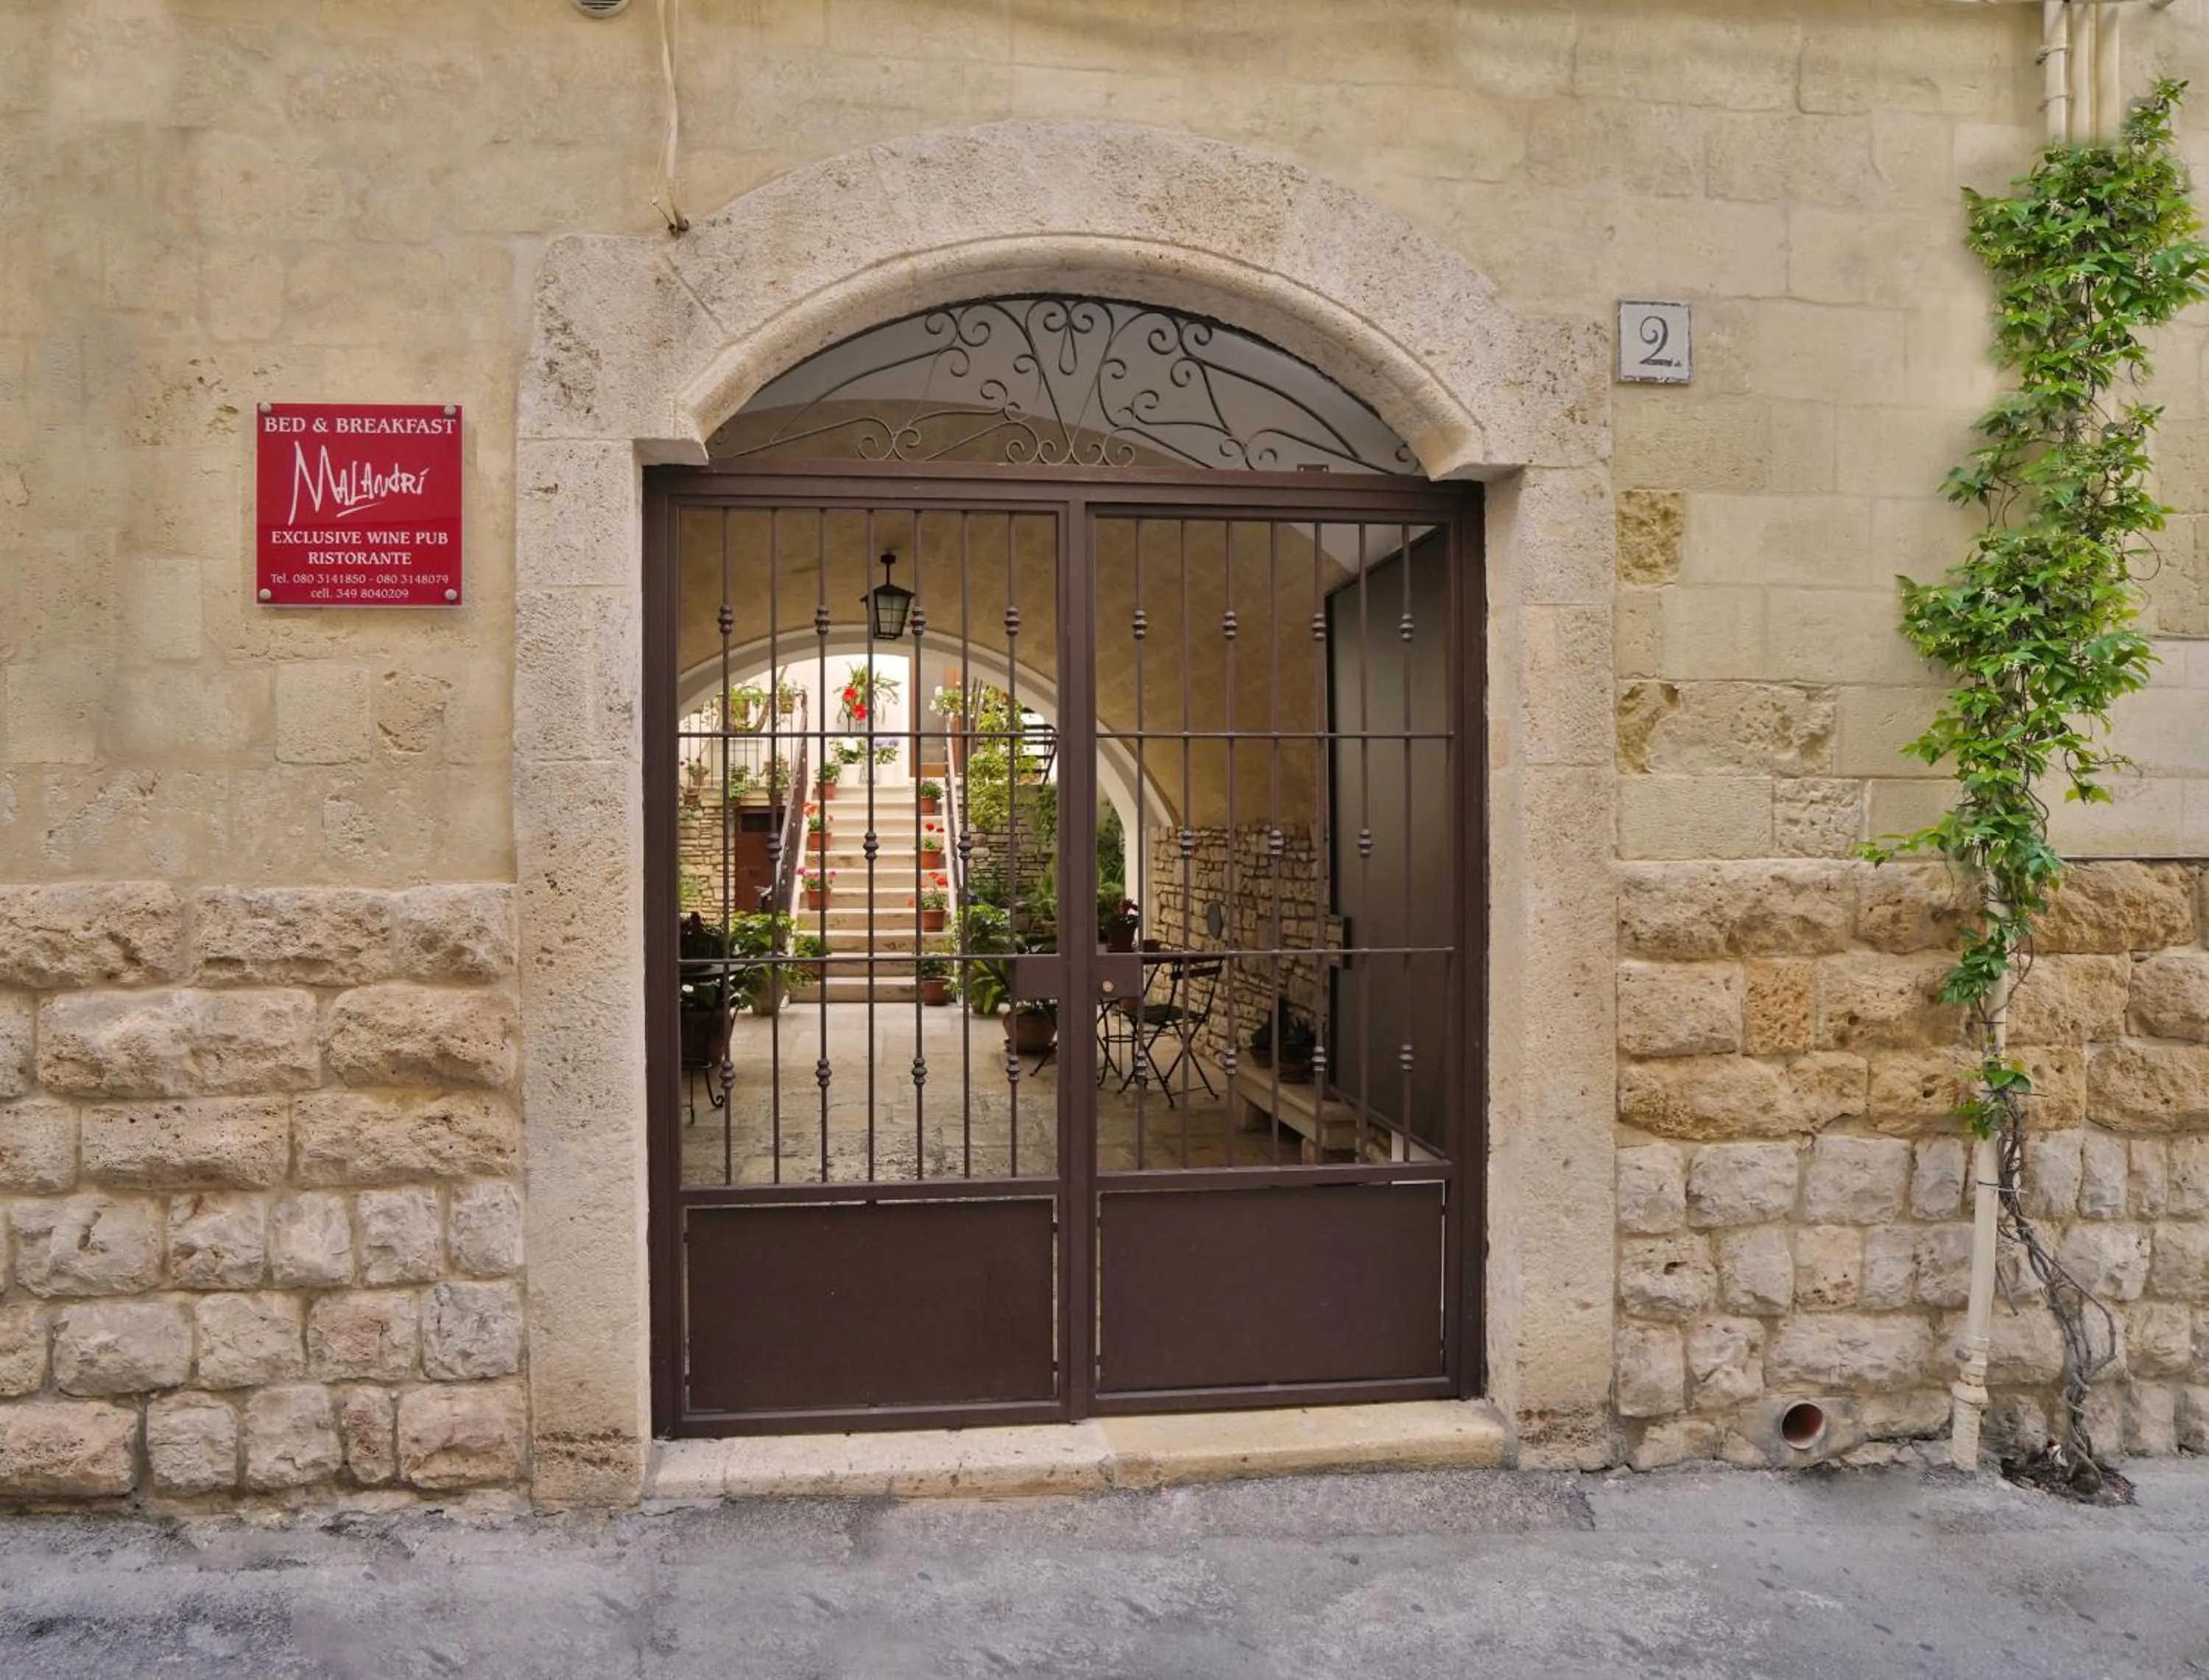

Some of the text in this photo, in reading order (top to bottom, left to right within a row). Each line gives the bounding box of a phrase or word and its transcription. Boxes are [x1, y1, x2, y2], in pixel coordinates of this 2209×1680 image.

[264, 417, 456, 434] BED & BREAKFAST
[271, 531, 448, 545] EXCLUSIVE WINE PUB
[308, 551, 412, 565] RISTORANTE
[270, 573, 289, 584] Tel.
[292, 573, 314, 584] 080
[317, 573, 366, 584] 3141850
[376, 573, 398, 584] 080
[401, 574, 448, 584] 3148079
[311, 588, 409, 599] cell. 349 8040209
